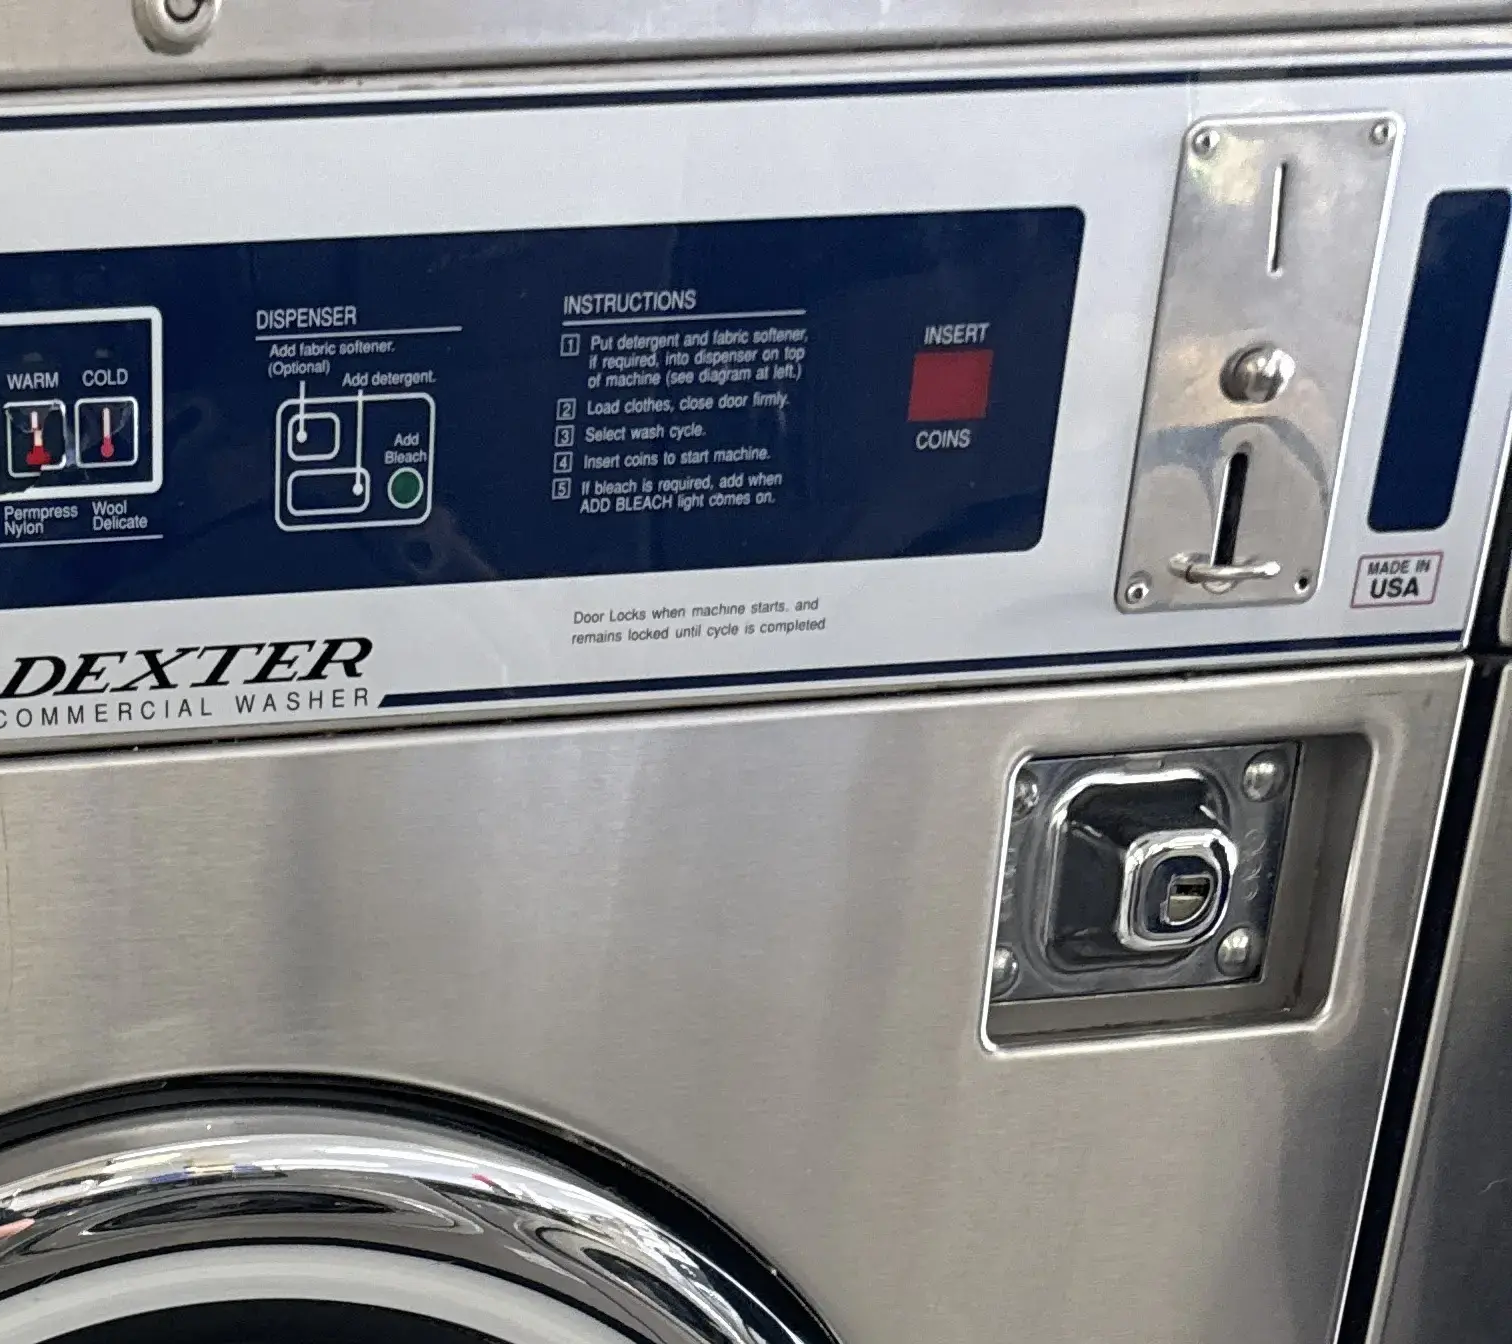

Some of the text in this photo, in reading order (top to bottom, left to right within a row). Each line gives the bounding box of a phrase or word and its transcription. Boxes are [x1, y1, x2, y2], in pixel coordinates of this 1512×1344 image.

[563, 290, 696, 315] INSTRUCTIONS
[256, 305, 357, 329] DISPENSER
[590, 335, 614, 351] Put
[617, 333, 680, 352] detergent
[683, 330, 709, 347] and
[713, 328, 748, 345] fabric
[752, 327, 808, 344] softener,
[924, 322, 989, 345] INSERT
[269, 339, 395, 358] Add fabric softener.
[589, 345, 805, 372] if required, into dispenser on top
[82, 368, 128, 387] COLD
[268, 360, 330, 379] (Optional)
[342, 370, 436, 388] Add detergent.
[587, 363, 802, 389] of machine (see diagram at left.)
[7, 372, 59, 390] WARM
[587, 399, 620, 416] Load
[624, 397, 674, 413] clothes,
[679, 395, 713, 411] close
[718, 394, 748, 409] door
[752, 391, 789, 410] firmly.
[394, 432, 419, 447] Add
[585, 426, 626, 443] Select
[630, 424, 664, 440] wash
[669, 422, 706, 442] cycle.
[915, 428, 971, 450] COINS
[384, 449, 427, 465] Bleach
[583, 453, 620, 469] Insert
[624, 452, 658, 467] coins
[663, 450, 676, 466] to
[680, 449, 709, 465] start
[713, 446, 771, 463] machine.
[581, 480, 590, 496] If
[594, 478, 637, 496] bleach
[641, 477, 652, 493] is
[658, 475, 714, 494] required,
[718, 472, 744, 488] add
[748, 471, 783, 487] when
[92, 500, 127, 516] Wool
[579, 491, 776, 514] ADD BLEACH light comes on.
[4, 504, 79, 524] Permpress
[92, 515, 148, 532] Delicate
[4, 520, 44, 539] Nylon
[1368, 559, 1431, 575] MADE IN
[1370, 577, 1419, 599] USA
[574, 610, 604, 625] Door
[609, 608, 646, 623] Locks
[652, 605, 685, 620] when
[692, 602, 745, 618] machine
[795, 597, 819, 612] and
[572, 617, 826, 645] remains locked until cycle is completed
[235, 687, 369, 715] WASHER
